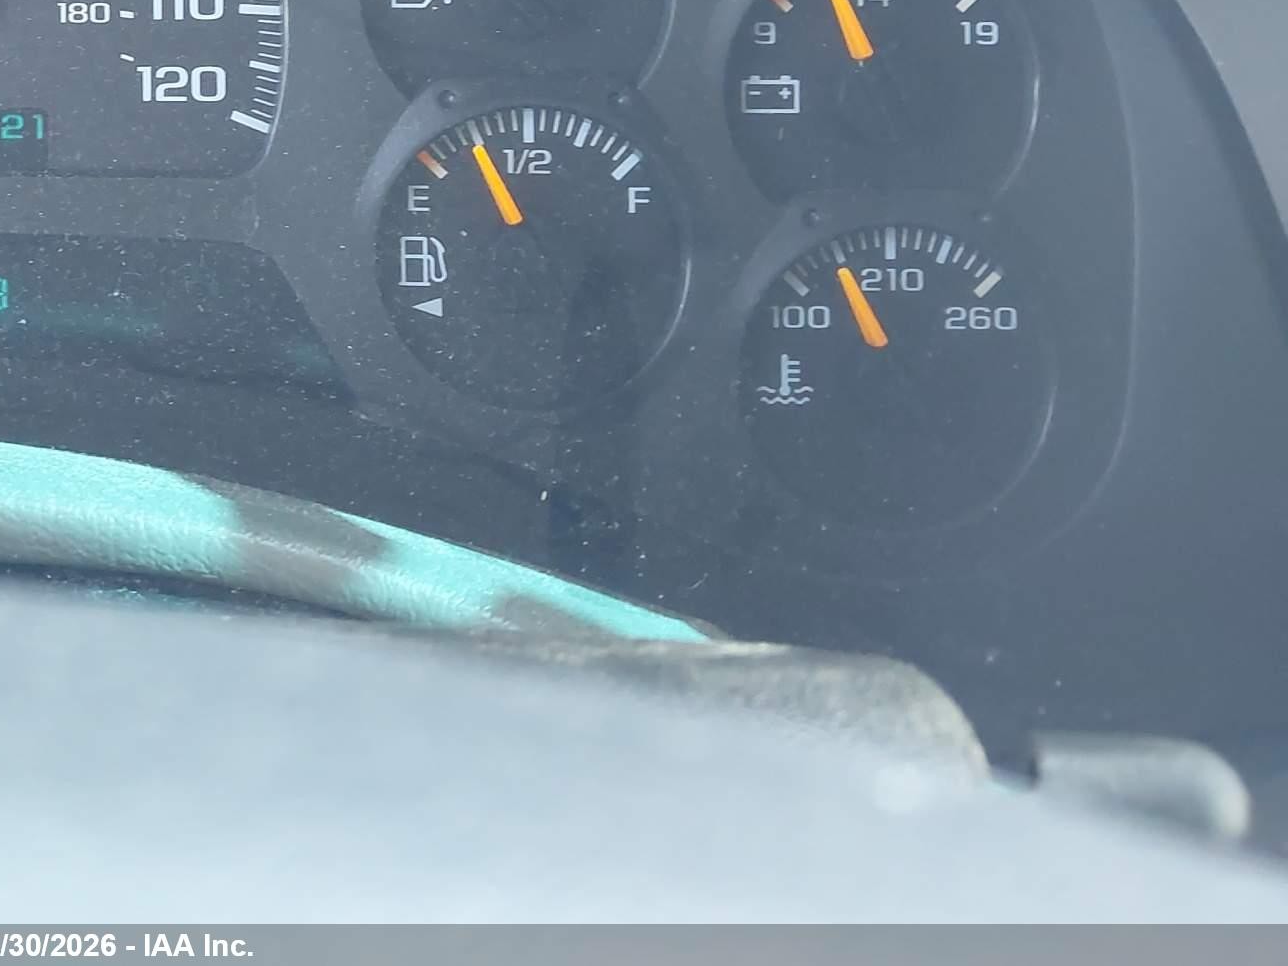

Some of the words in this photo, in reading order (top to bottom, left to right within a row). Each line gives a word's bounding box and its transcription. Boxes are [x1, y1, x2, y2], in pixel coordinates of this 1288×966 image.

[58, 2, 111, 25] 180
[754, 22, 776, 45] 9
[962, 22, 1000, 45] 19
[138, 67, 227, 102] 120
[503, 149, 552, 176] 1/2
[407, 186, 430, 212] E
[627, 187, 651, 214] F
[861, 269, 925, 293] 210
[771, 306, 831, 330] 100
[944, 307, 1018, 332] 260
